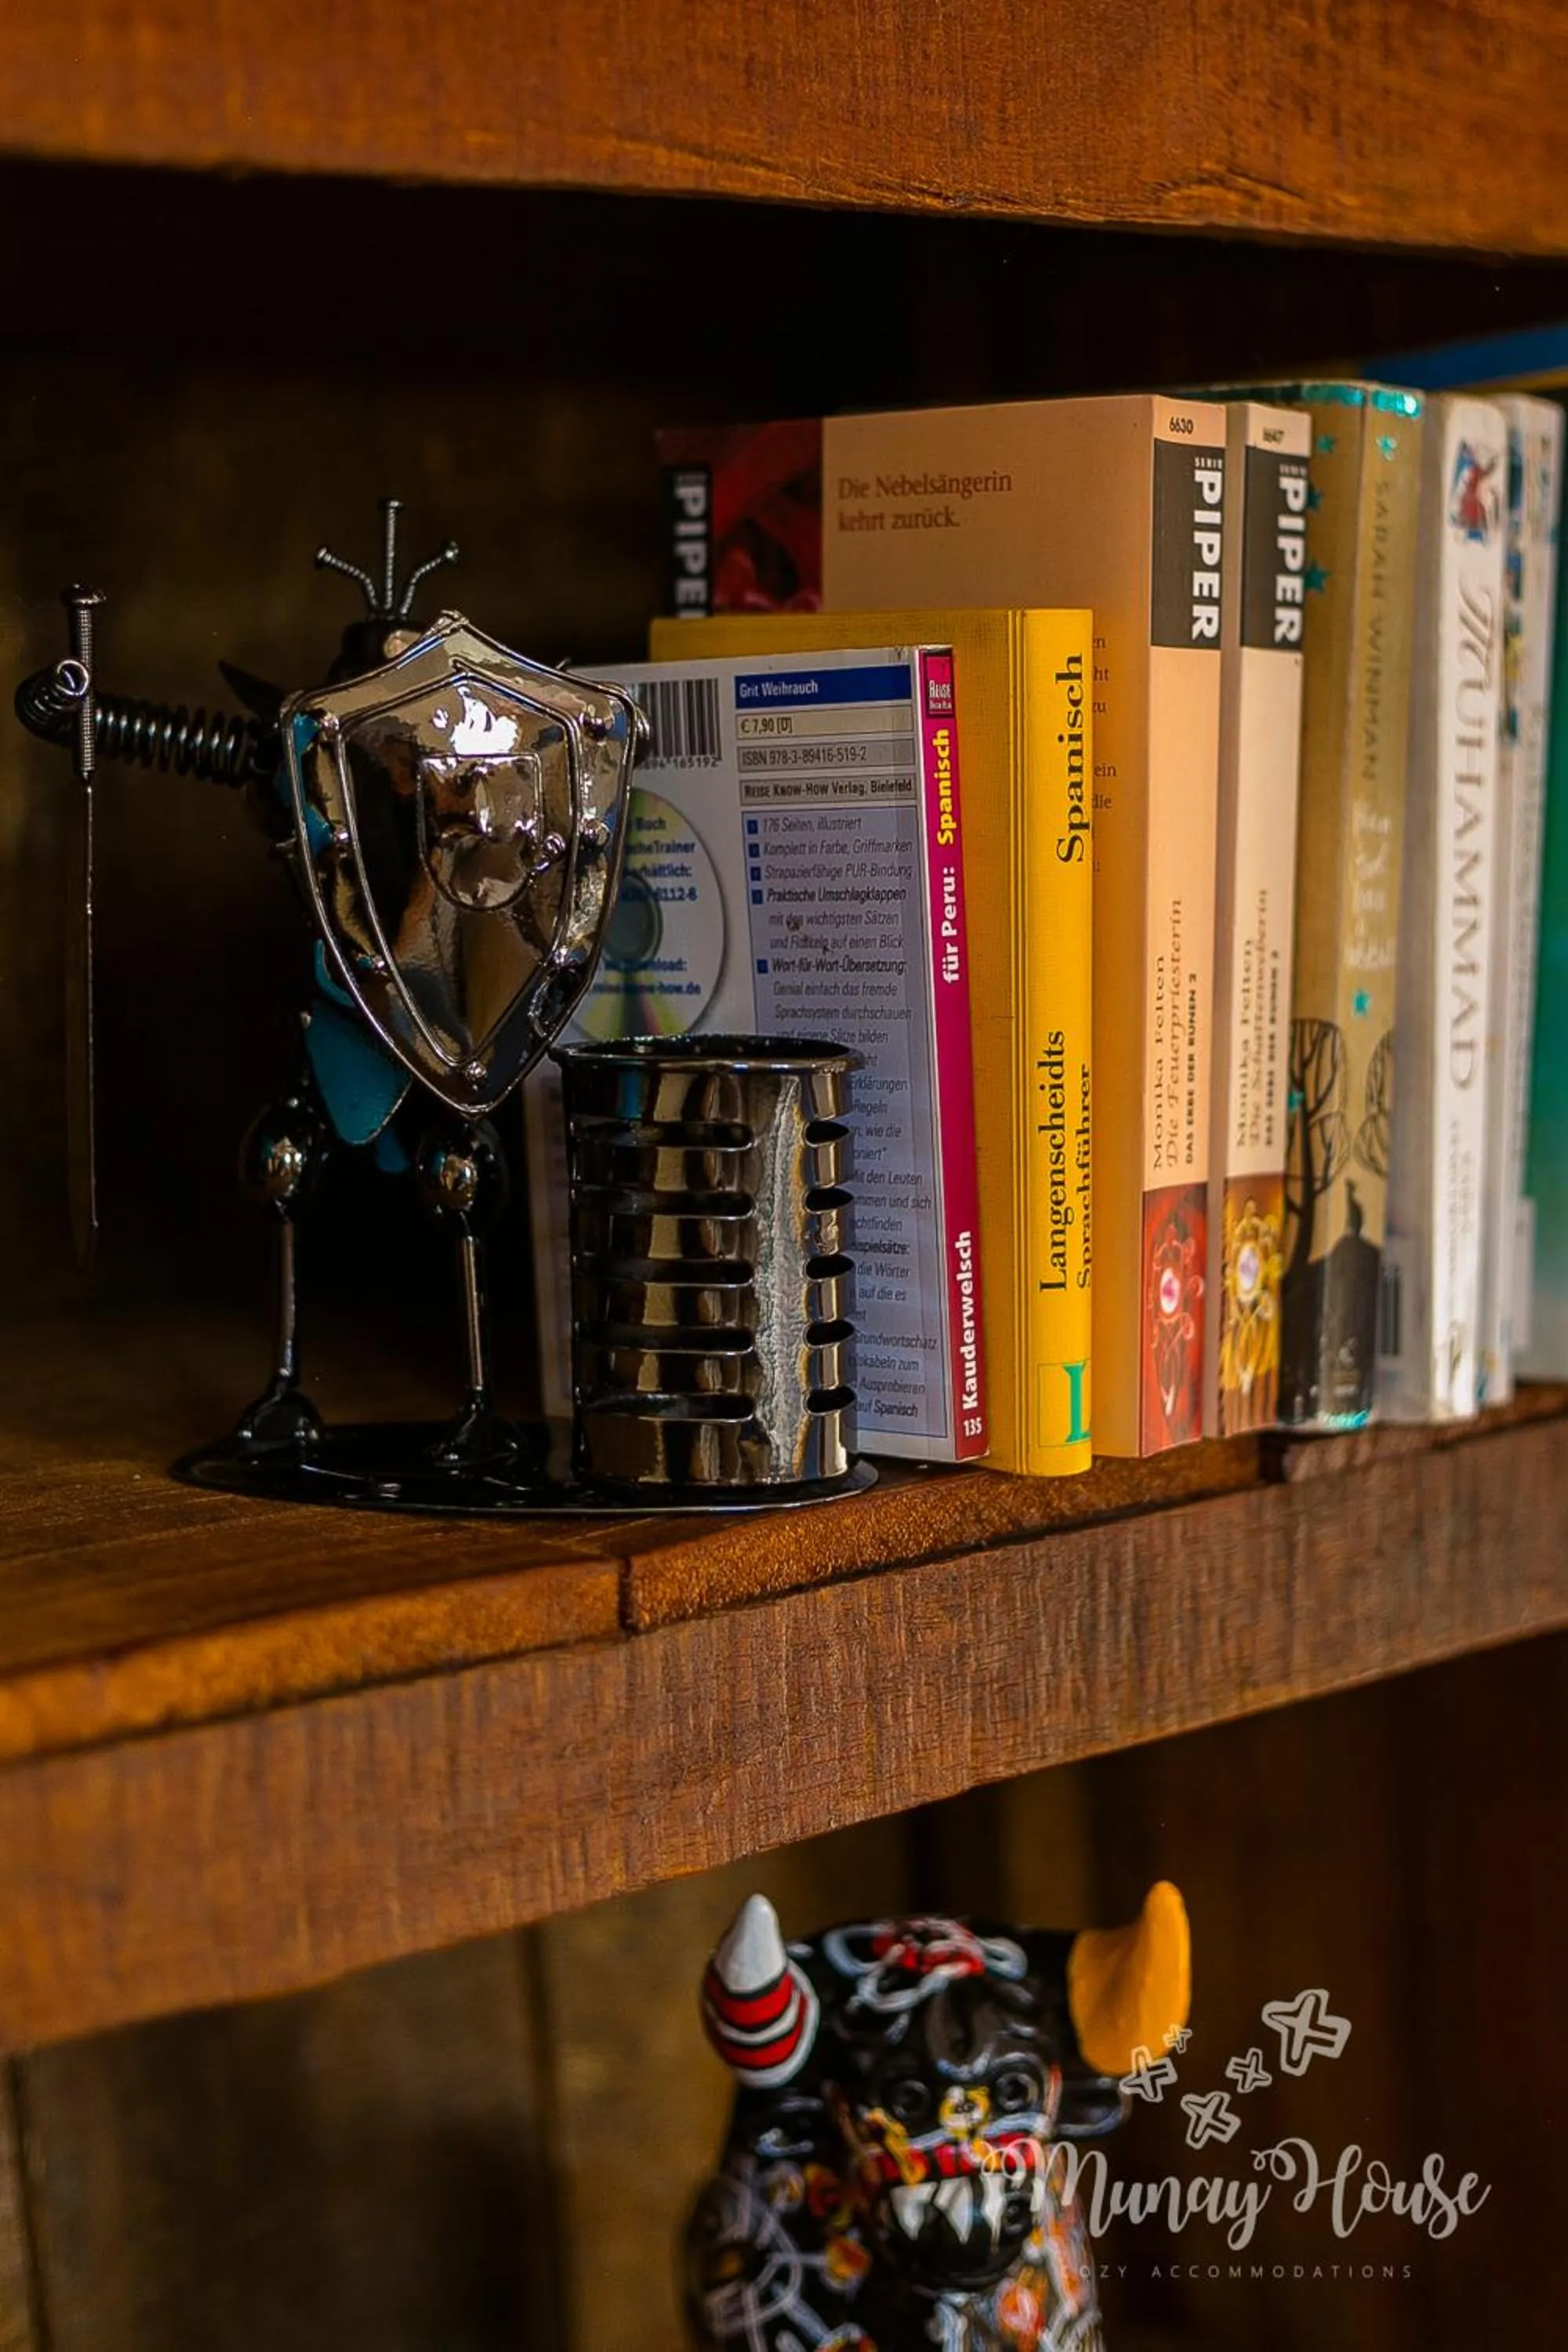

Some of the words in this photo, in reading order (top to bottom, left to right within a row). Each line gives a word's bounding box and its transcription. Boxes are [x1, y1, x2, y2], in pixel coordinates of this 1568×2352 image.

[1169, 416, 1194, 435] 6630
[838, 477, 868, 499] Die
[876, 471, 1012, 500] Nebelsängerin
[838, 510, 884, 532] kehrt
[891, 506, 960, 529] zurück.
[1191, 470, 1222, 640] PIPER
[1275, 477, 1308, 643] PIPER
[739, 683, 759, 698] Grit
[762, 680, 818, 696] Weihrauch
[741, 718, 750, 733] €
[753, 718, 774, 734] 7,90
[742, 750, 768, 766] ISBN
[769, 746, 867, 765] 978-3-89416-519-2
[1054, 652, 1090, 863] Spanisch
[870, 779, 912, 793] Bielefeld
[933, 729, 956, 845] Spanisch
[763, 842, 806, 857] Komplett
[808, 842, 818, 854] in
[852, 838, 913, 854] Griffmarken
[845, 863, 913, 880] PUR-Bindung
[818, 887, 906, 905] Umschlagklappen
[942, 867, 957, 938] Peru:
[879, 933, 904, 949] Blick
[942, 942, 960, 984] für
[805, 982, 840, 996] einfach
[842, 982, 859, 996] das
[1155, 956, 1166, 1044] Felten
[1167, 899, 1187, 1109] Feuerpriesterin
[1188, 989, 1197, 1047] RUNEN
[1187, 1053, 1196, 1083] DER
[1153, 1058, 1166, 1170] Monika
[1186, 1088, 1196, 1127] ERBE
[1037, 1030, 1074, 1292] Langenscheidts
[1185, 1131, 1195, 1164] DAS
[1075, 1064, 1092, 1290] Sprachführer
[954, 1230, 978, 1410] Kauderwelsch
[873, 1399, 918, 1418] Spanisch
[963, 1417, 982, 1437] 135
